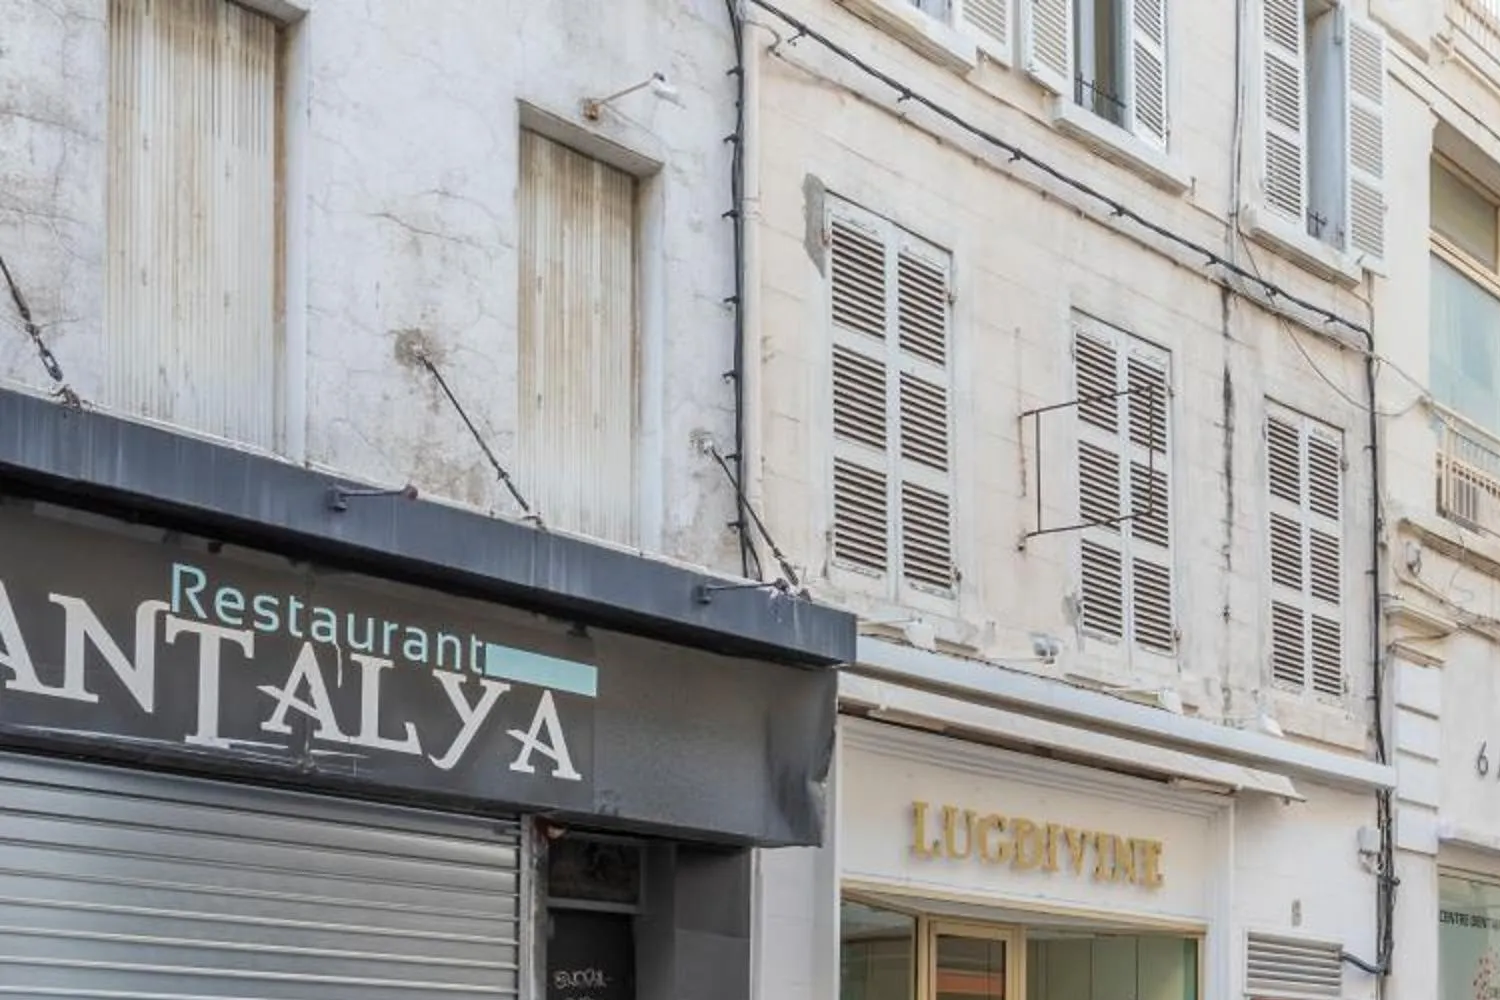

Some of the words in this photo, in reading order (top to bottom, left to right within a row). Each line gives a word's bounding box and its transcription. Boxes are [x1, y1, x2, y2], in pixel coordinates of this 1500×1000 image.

[171, 562, 484, 675] Restaurant
[1476, 740, 1490, 778] 6
[910, 800, 1164, 890] LUGDIVINE
